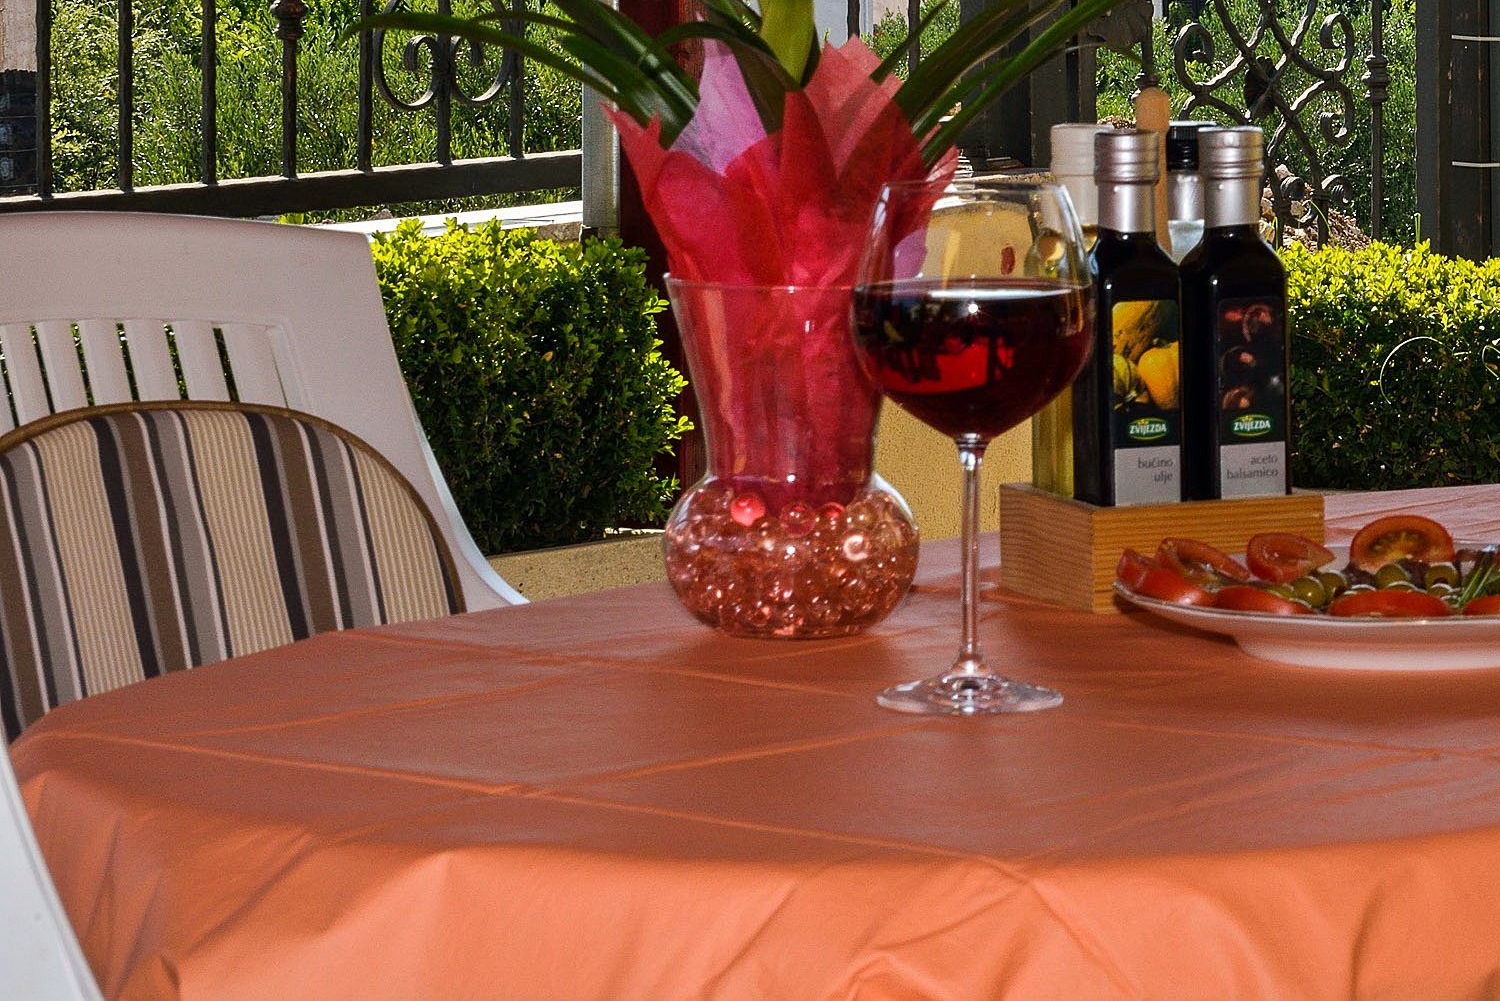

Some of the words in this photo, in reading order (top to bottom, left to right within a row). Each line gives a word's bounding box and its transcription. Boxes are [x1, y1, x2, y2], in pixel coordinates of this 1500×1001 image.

[1129, 423, 1167, 435] ZVIJEZDA
[1233, 419, 1271, 432] ZVIJEZDA
[1249, 454, 1279, 466] aceto
[1153, 470, 1173, 484] ulje
[1226, 466, 1279, 480] balsamico
